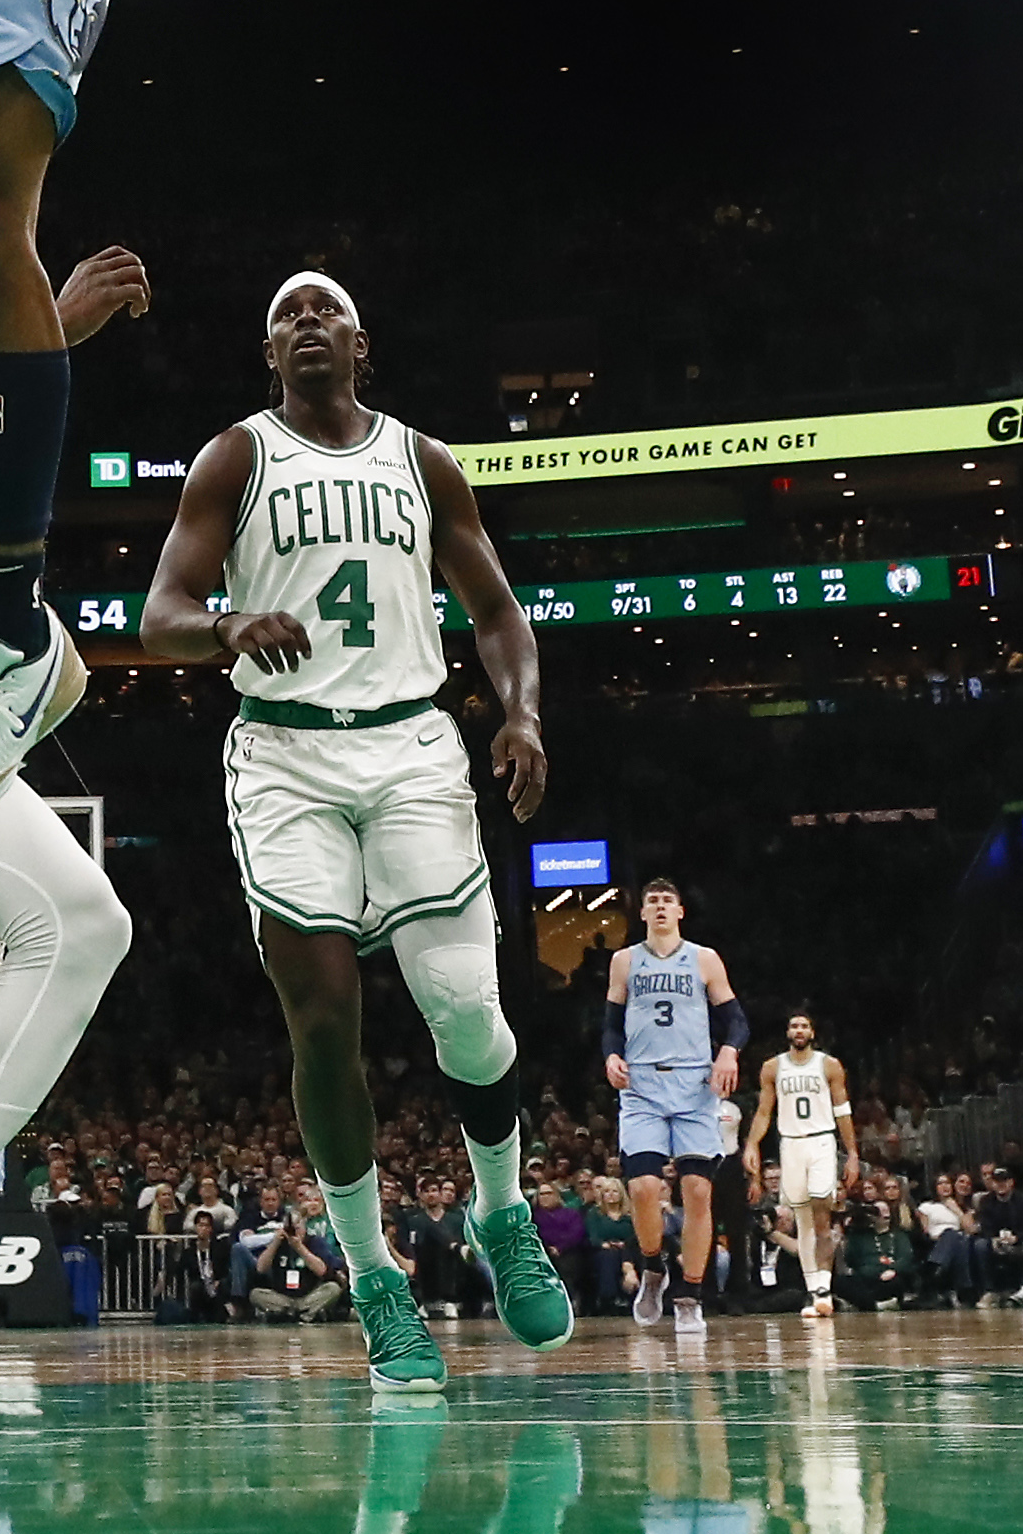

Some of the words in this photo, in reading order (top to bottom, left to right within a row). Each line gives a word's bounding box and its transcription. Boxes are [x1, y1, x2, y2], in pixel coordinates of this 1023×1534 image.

[367, 456, 406, 470] Amica
[476, 456, 513, 473] THE
[521, 452, 570, 470] BEST
[577, 447, 639, 466] YOUR
[648, 442, 712, 461] GAME
[721, 437, 768, 455] CAN
[777, 433, 817, 450] GET
[93, 458, 126, 481] TD
[136, 460, 186, 477] Bank
[268, 479, 415, 556] CELTICS
[538, 588, 555, 599] FG
[615, 583, 636, 594] 3PT
[679, 579, 696, 590] TO
[725, 575, 745, 587] STL
[772, 572, 796, 584] AST
[820, 568, 844, 581] REB
[957, 566, 981, 587] 21
[316, 560, 375, 648] 4
[525, 602, 575, 621] 18/50
[611, 597, 652, 615] 9/31
[683, 594, 696, 611] 6
[730, 591, 744, 608] 4
[776, 587, 798, 604] 13
[823, 584, 847, 602] 22
[78, 599, 127, 632] 54
[540, 858, 602, 871] ticketmaster
[633, 973, 693, 997] GRIZZLIES
[654, 1000, 674, 1027] 3
[780, 1075, 821, 1096] CELTICS
[796, 1097, 810, 1119] 0
